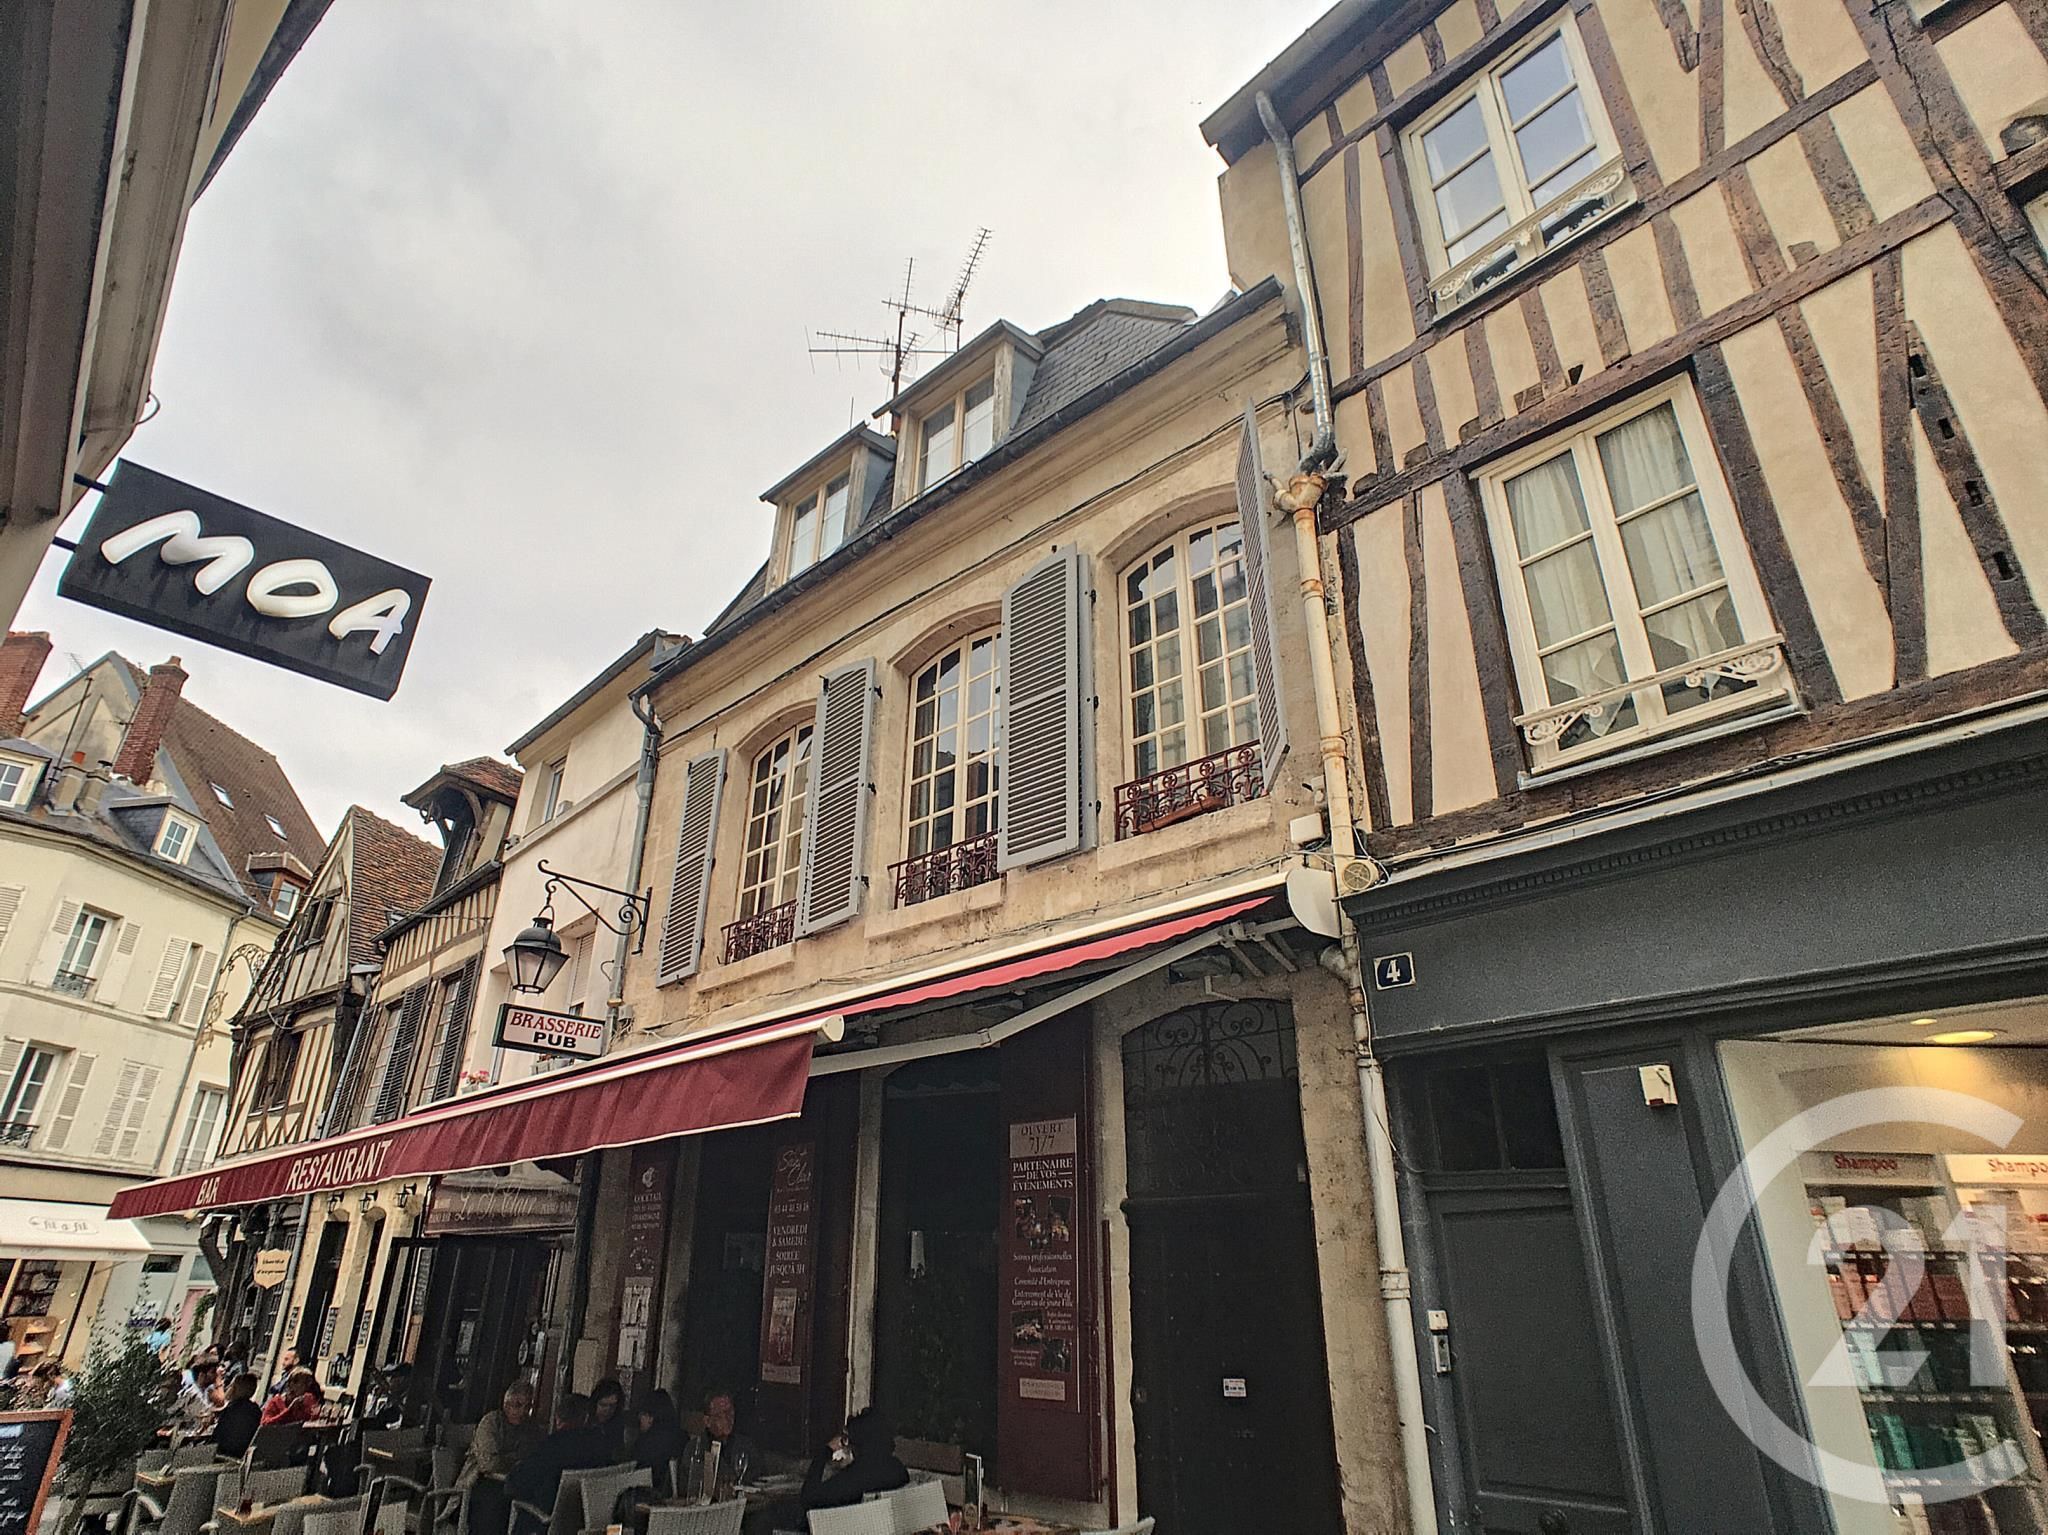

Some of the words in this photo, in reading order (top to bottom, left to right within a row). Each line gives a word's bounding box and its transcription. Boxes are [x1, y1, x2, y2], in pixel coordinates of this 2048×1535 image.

[100, 509, 411, 656] MOA
[1386, 959, 1401, 982] 4
[510, 1010, 602, 1039] BRASSERIE
[533, 1031, 577, 1049] PUB
[1021, 1122, 1064, 1136] OUVERT
[1013, 1158, 1073, 1172] PARTENAIRE
[1833, 1153, 1898, 1172] Shampoo
[195, 1176, 221, 1206] BAR
[284, 1138, 393, 1193] RESTAURANT
[1026, 1171, 1040, 1180] DE
[1040, 1169, 1058, 1180] VOS
[773, 1224, 808, 1236] VENDREDI
